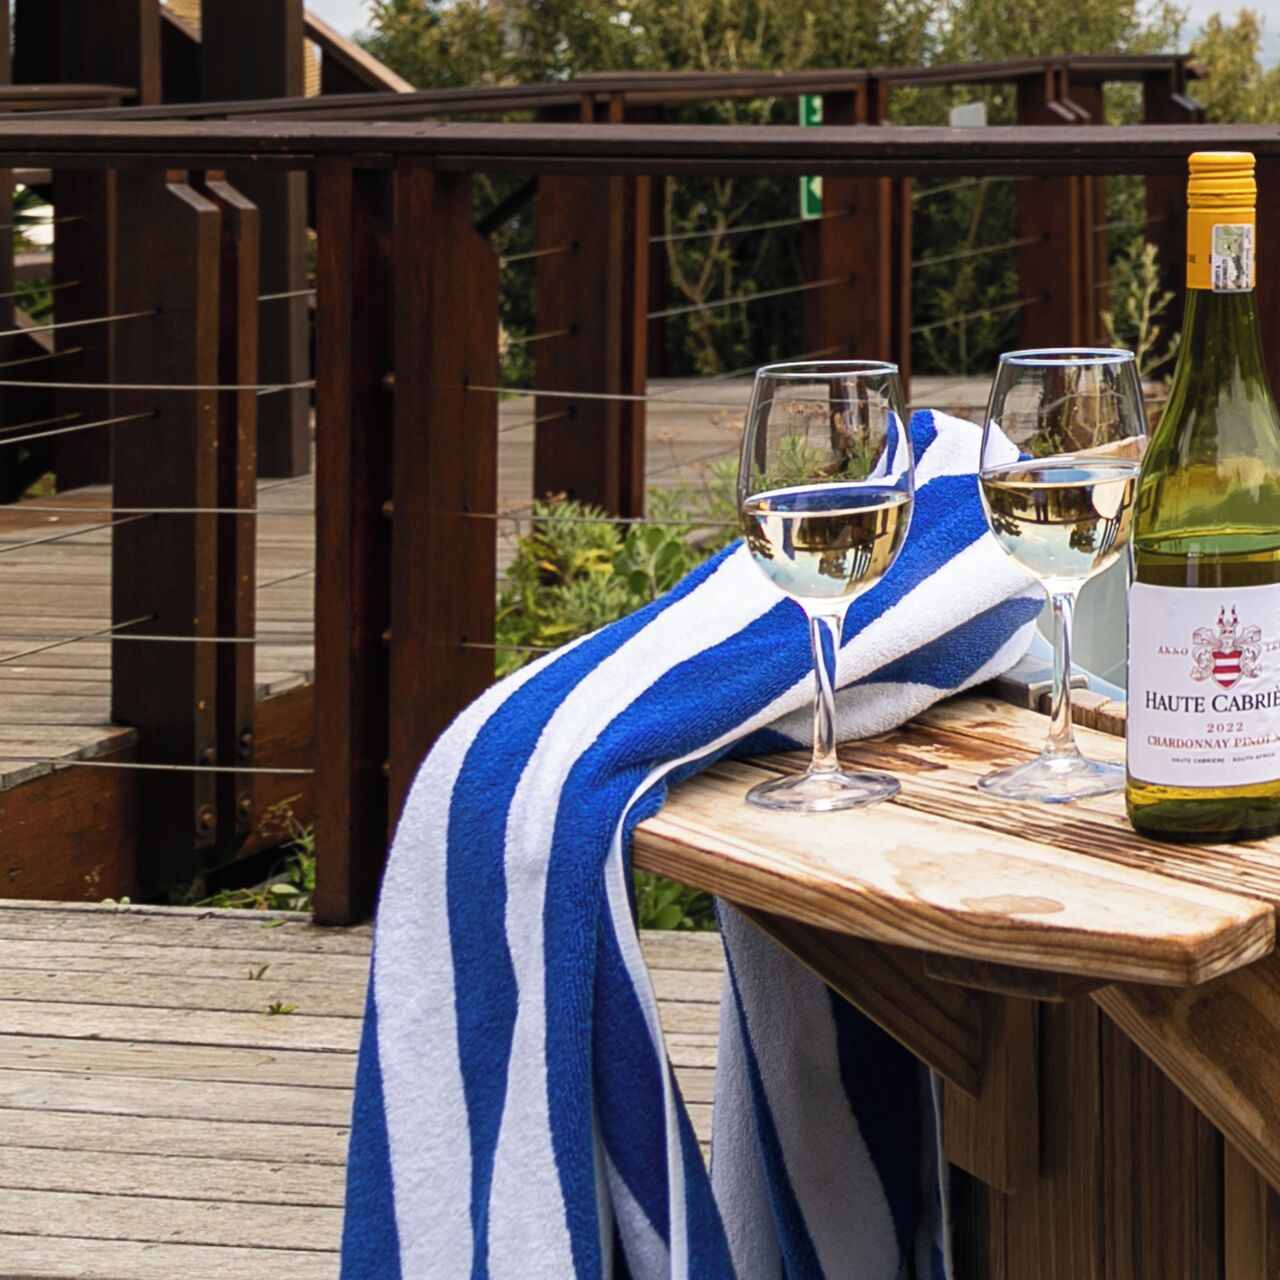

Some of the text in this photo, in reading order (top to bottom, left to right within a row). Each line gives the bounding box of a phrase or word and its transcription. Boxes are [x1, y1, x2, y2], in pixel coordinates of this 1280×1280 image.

[1145, 690, 1205, 713] HAUTE
[1206, 722, 1244, 733] 2022
[1147, 735, 1230, 749] CHARDONNAY
[1233, 735, 1271, 748] PINOT
[1232, 755, 1254, 763] SOUTH
